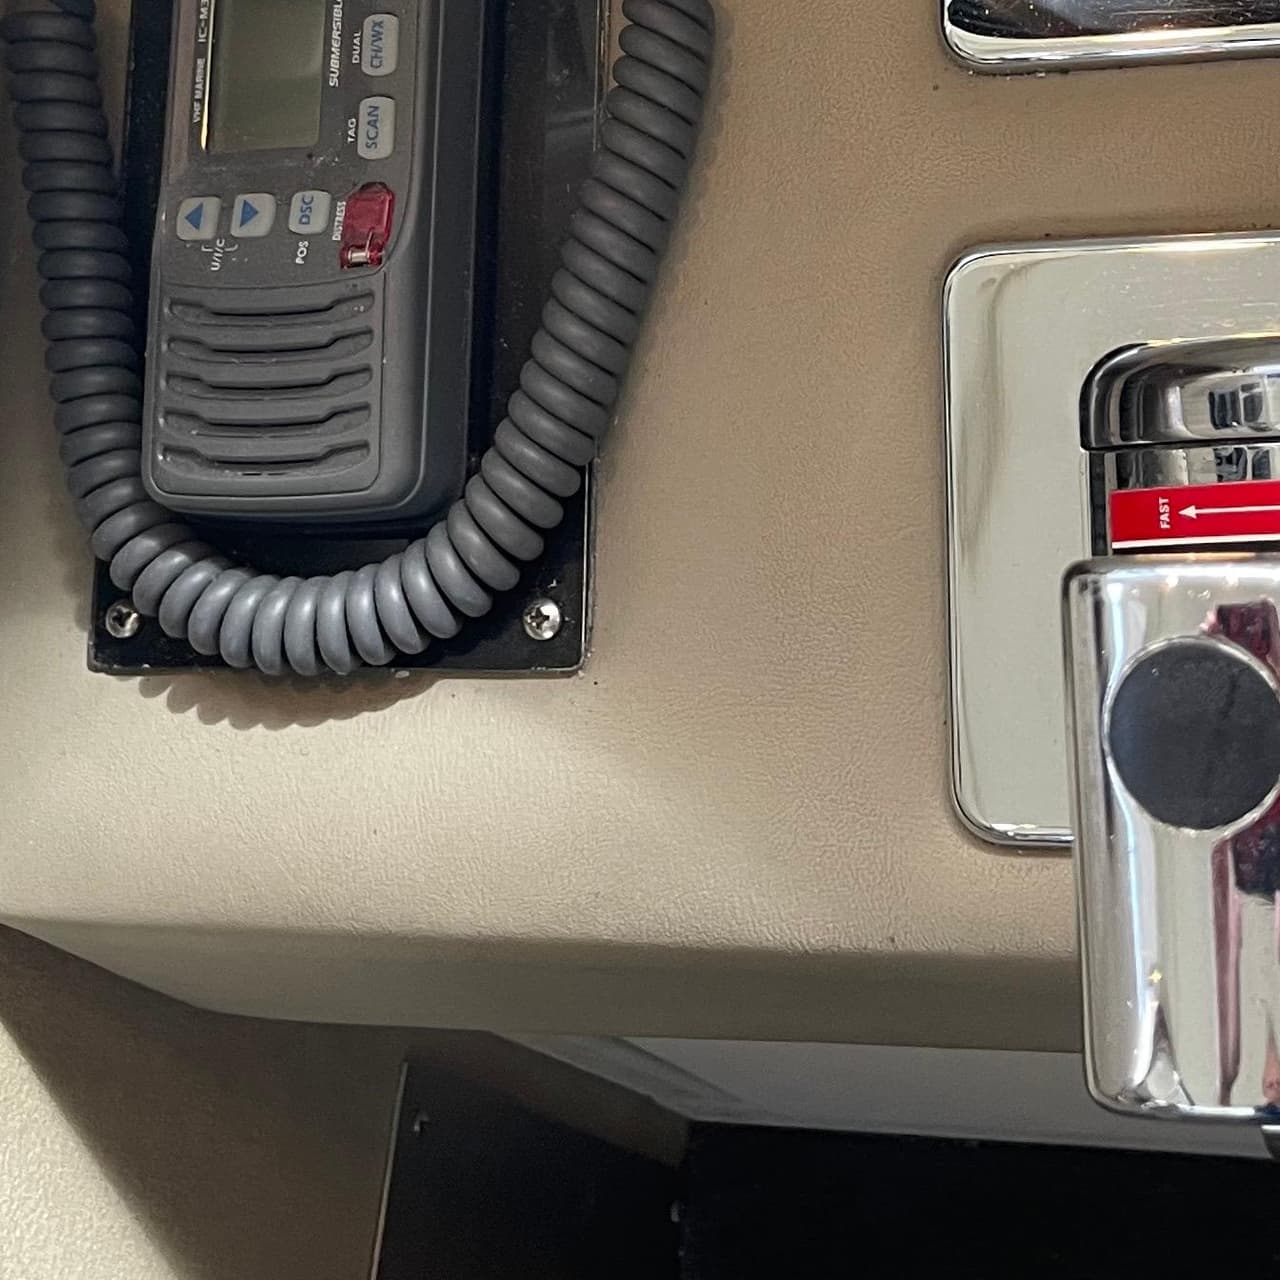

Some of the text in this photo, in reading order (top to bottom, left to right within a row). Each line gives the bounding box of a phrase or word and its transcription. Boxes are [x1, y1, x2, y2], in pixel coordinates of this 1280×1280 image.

[352, 30, 361, 64] DUAL
[370, 20, 384, 69] CH/WX
[194, 58, 206, 100] MARINE
[192, 102, 203, 124] VHF
[366, 105, 379, 149] SCAN
[347, 118, 356, 144] TAG
[299, 196, 314, 225] DSC
[332, 201, 347, 241] DISTRESS
[295, 240, 309, 264] POS
[1159, 497, 1171, 529] FAST
